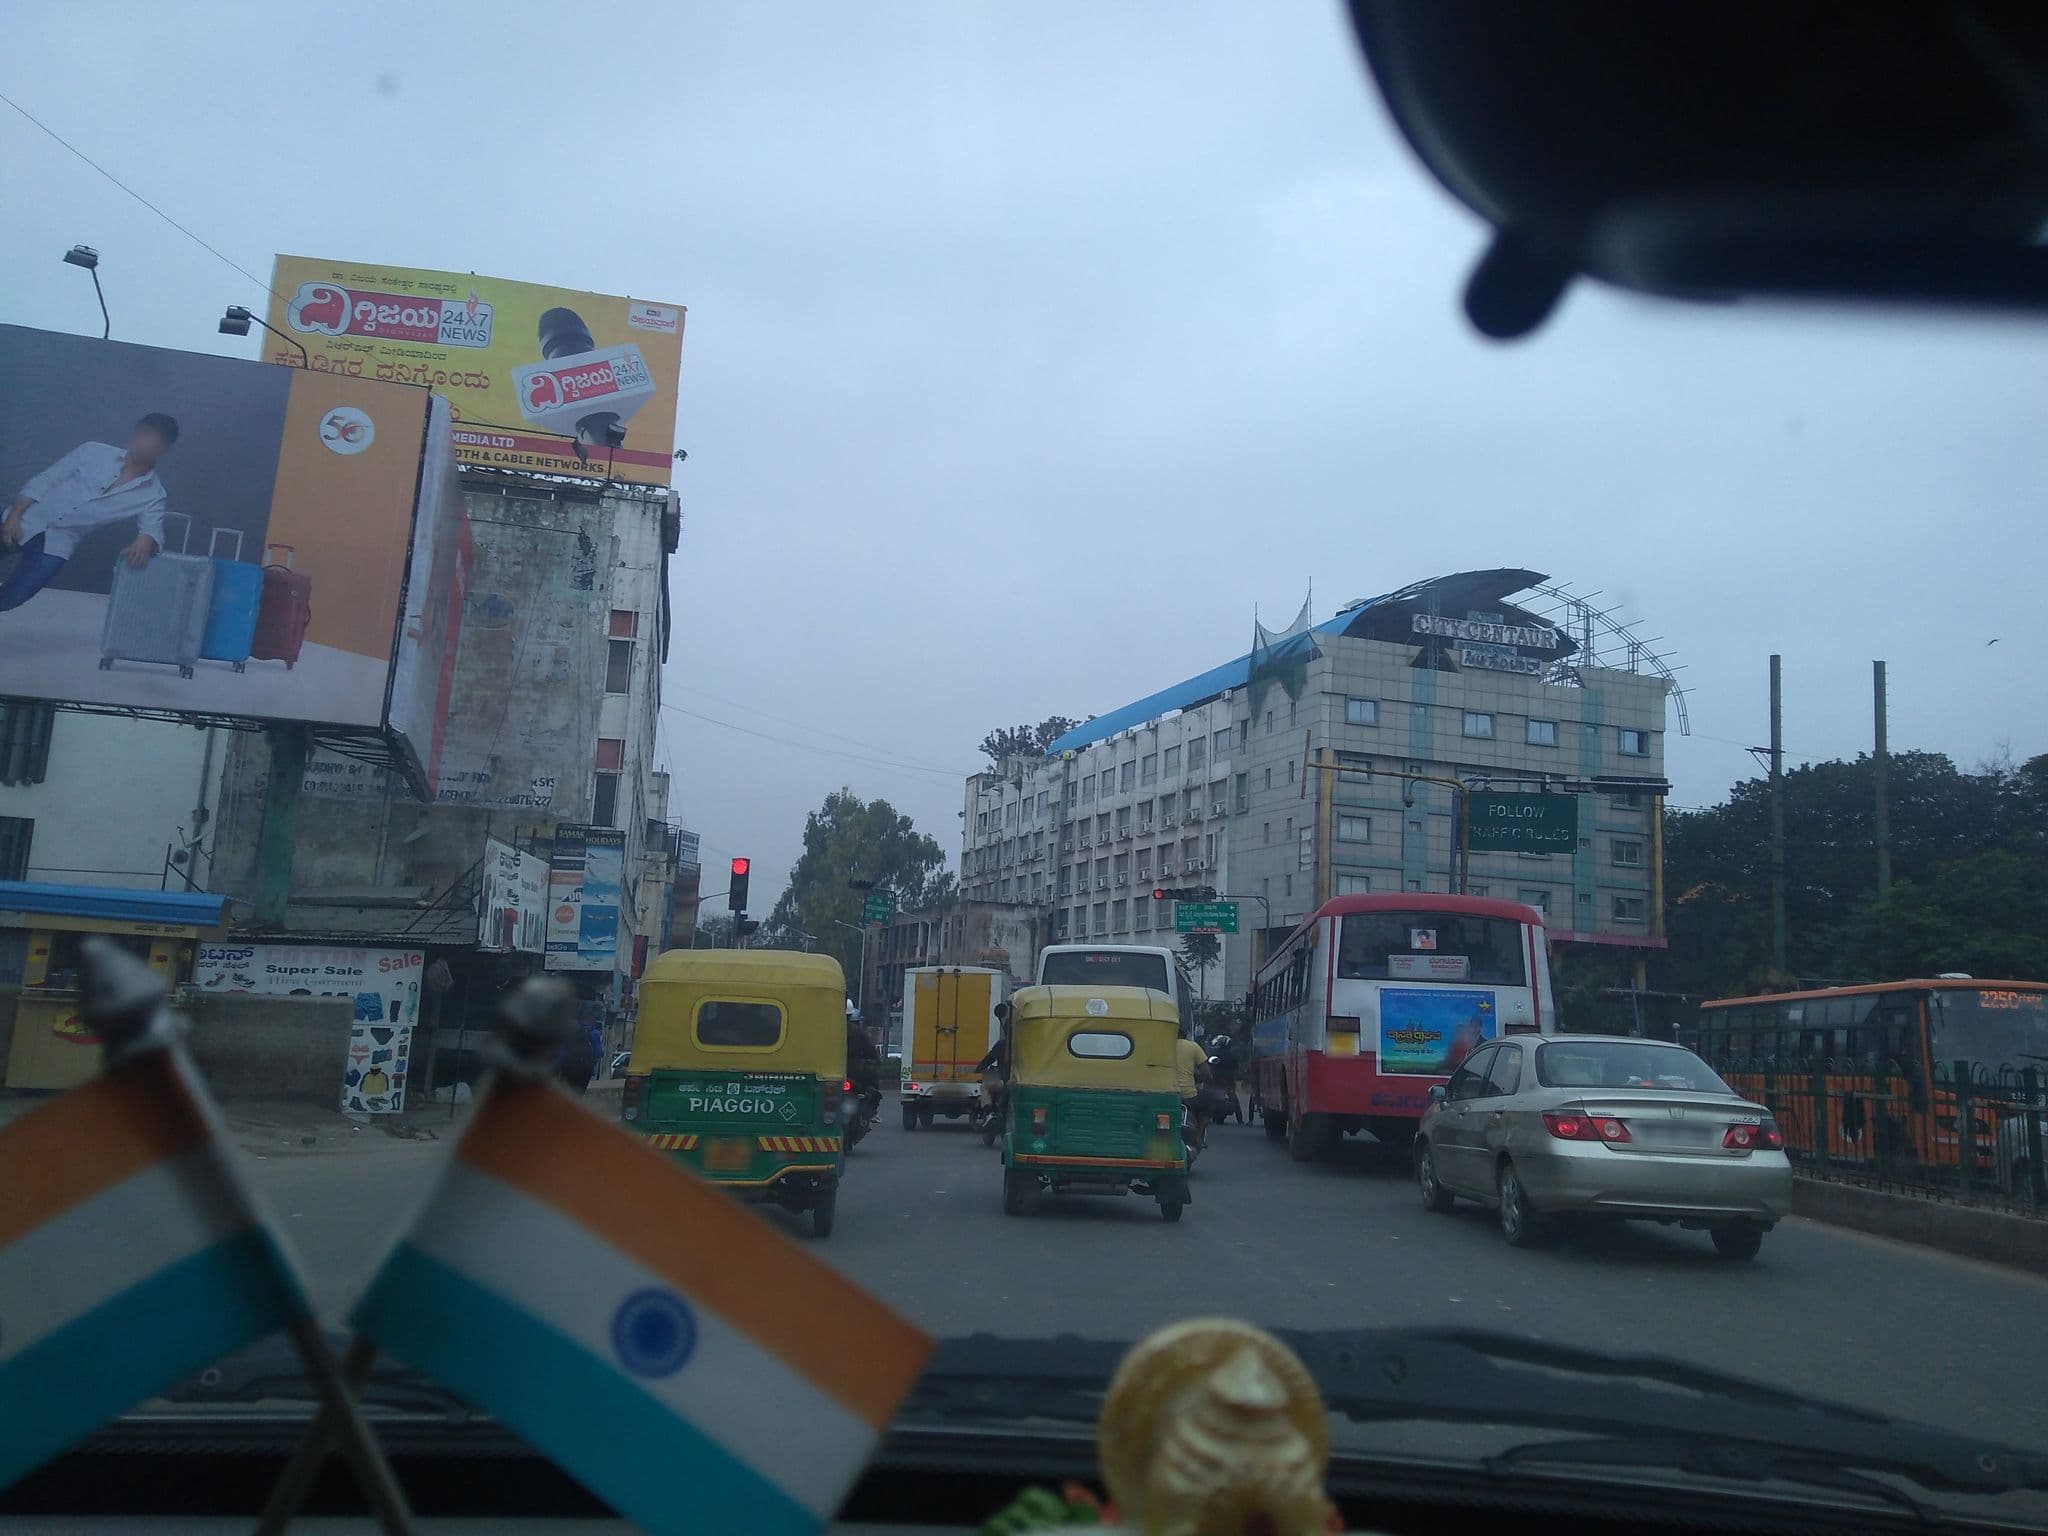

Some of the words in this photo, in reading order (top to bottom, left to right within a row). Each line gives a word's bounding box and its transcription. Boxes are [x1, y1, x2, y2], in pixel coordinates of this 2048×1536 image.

[443, 310, 488, 328] 24X7
[440, 327, 487, 342] NEWS
[617, 372, 645, 386] NEWS
[452, 432, 490, 446] MEDIA
[492, 436, 515, 448] LTD
[482, 452, 491, 461] &
[494, 452, 533, 465] CABLE
[536, 455, 604, 473] NETWORKS
[1416, 615, 1461, 638] CITY
[1468, 623, 1554, 650] CENTAUR
[1488, 804, 1545, 819] FOLLOW
[586, 837, 621, 846] HOLIDAYS
[265, 964, 319, 976] Super
[324, 966, 364, 976] Sale
[378, 953, 422, 974] Sale
[689, 1097, 774, 1114] PIAGGIO
